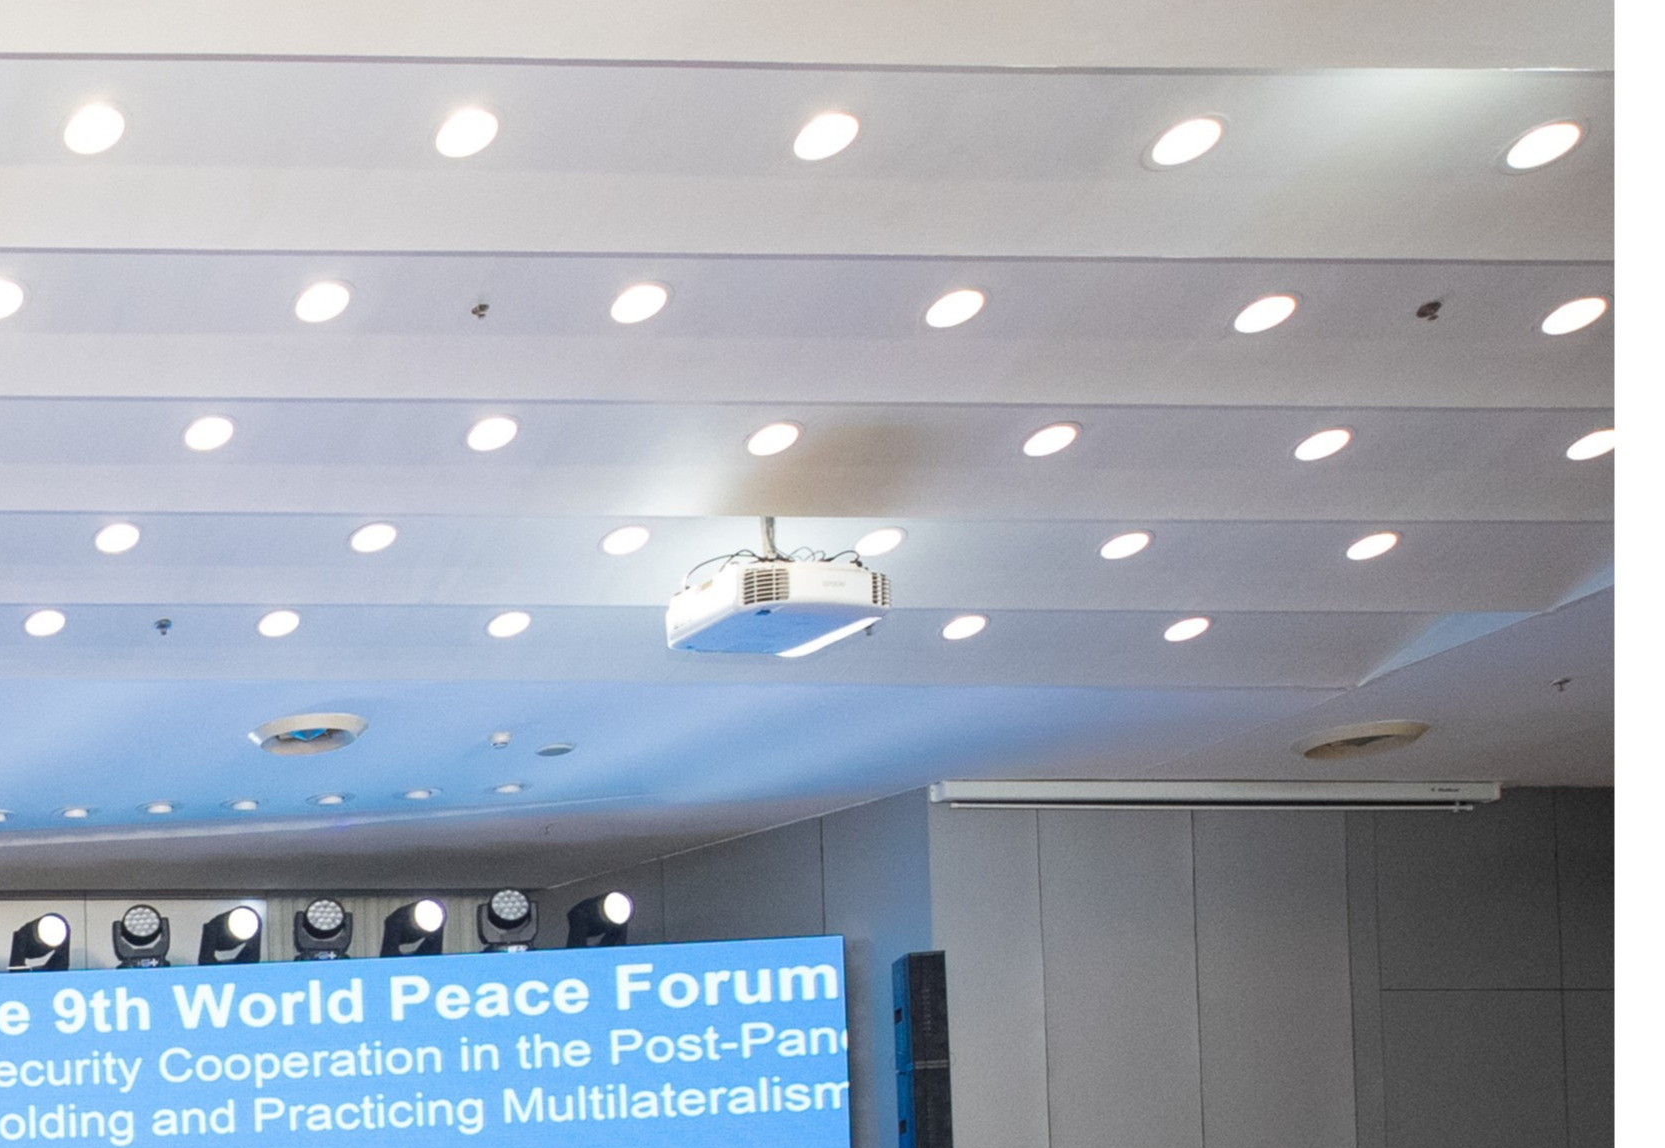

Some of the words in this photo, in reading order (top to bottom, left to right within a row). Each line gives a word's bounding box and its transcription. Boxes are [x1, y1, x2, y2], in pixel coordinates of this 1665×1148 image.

[53, 986, 151, 1035] 9th
[172, 978, 364, 1031] World
[390, 974, 590, 1022] Peace
[616, 963, 839, 1011] Forum
[158, 1040, 442, 1088] Cooperation
[460, 1036, 499, 1072] in
[516, 1033, 592, 1070] the
[152, 1099, 236, 1137] and
[254, 1092, 485, 1136] Practicing
[503, 1075, 850, 1125] Multilateralism
